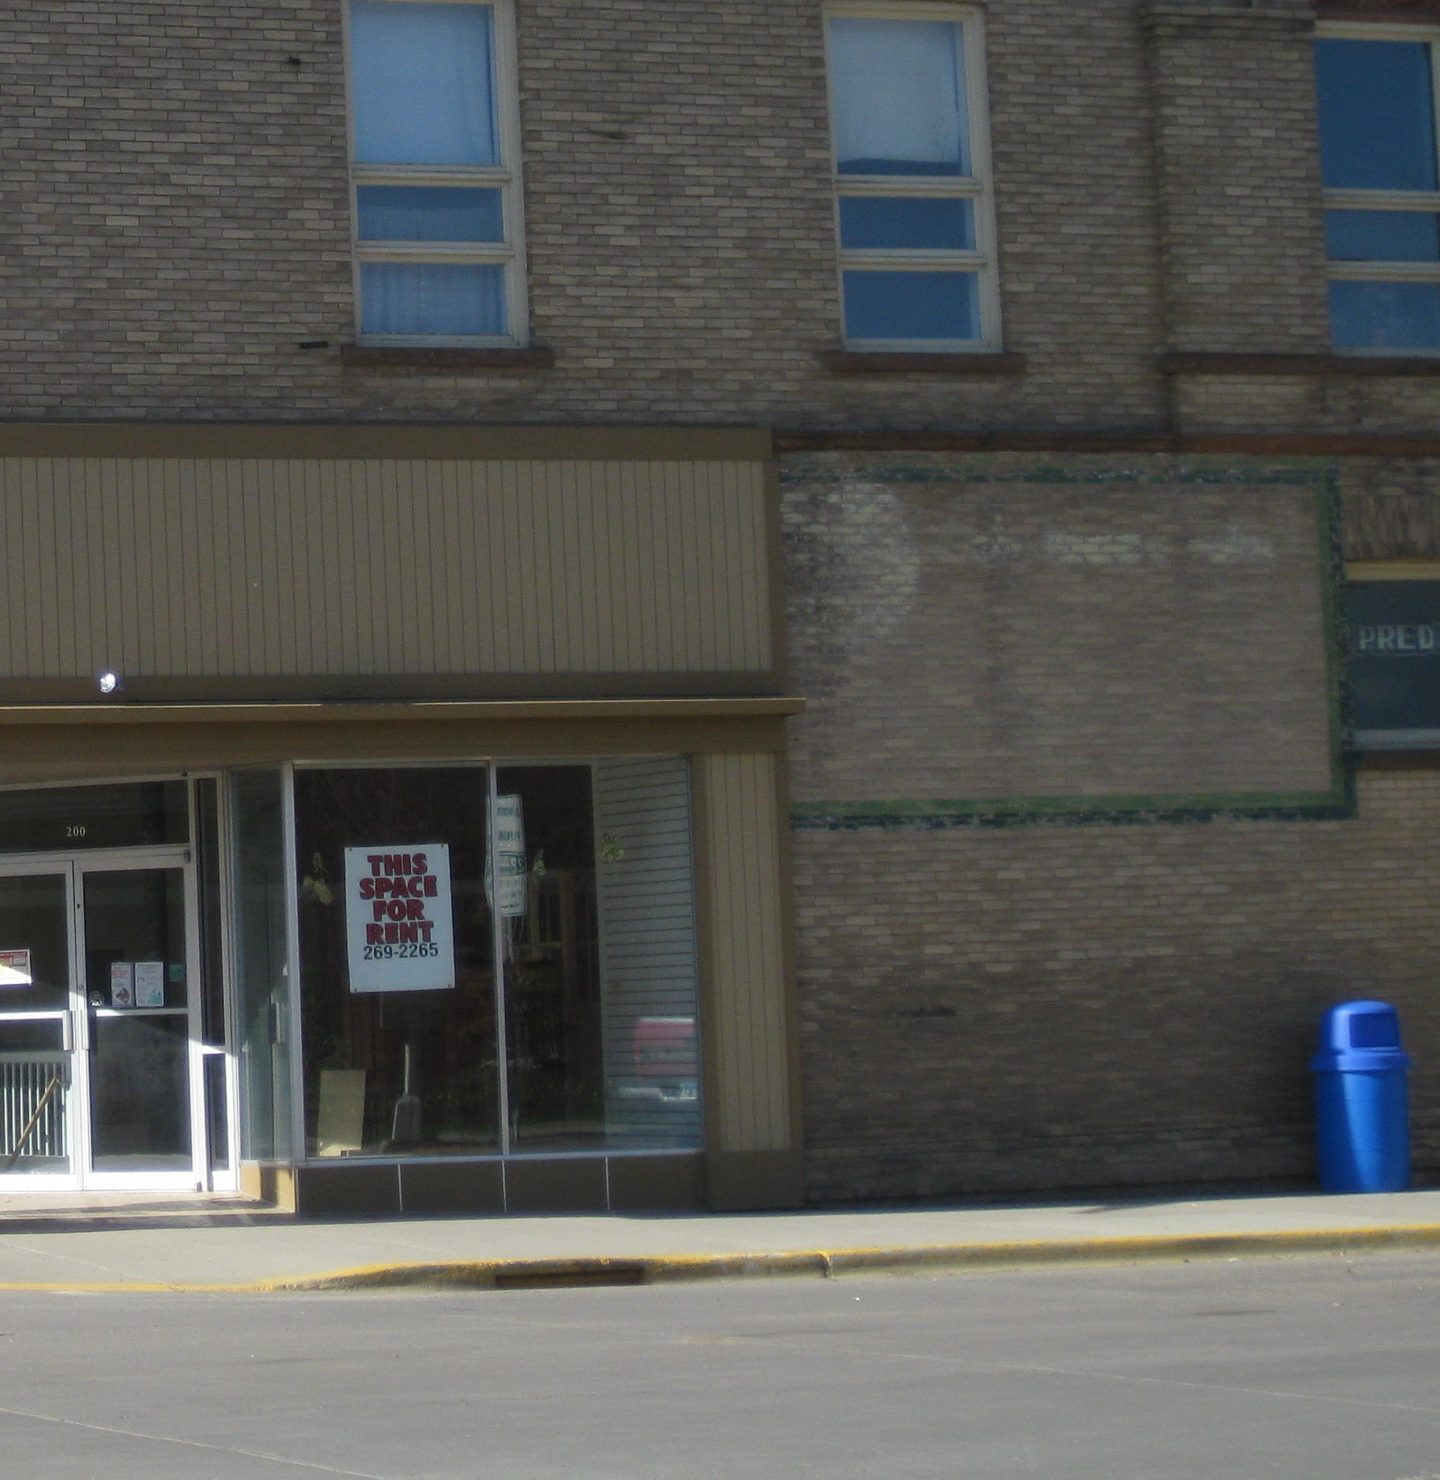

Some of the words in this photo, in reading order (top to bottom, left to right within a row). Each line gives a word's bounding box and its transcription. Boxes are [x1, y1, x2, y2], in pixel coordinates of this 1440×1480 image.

[65, 826, 87, 838] 200
[367, 853, 428, 877] THIS
[359, 875, 438, 900] SPACE
[372, 899, 426, 922] FOR
[365, 920, 435, 945] RENT
[363, 942, 439, 961] 269-2265
